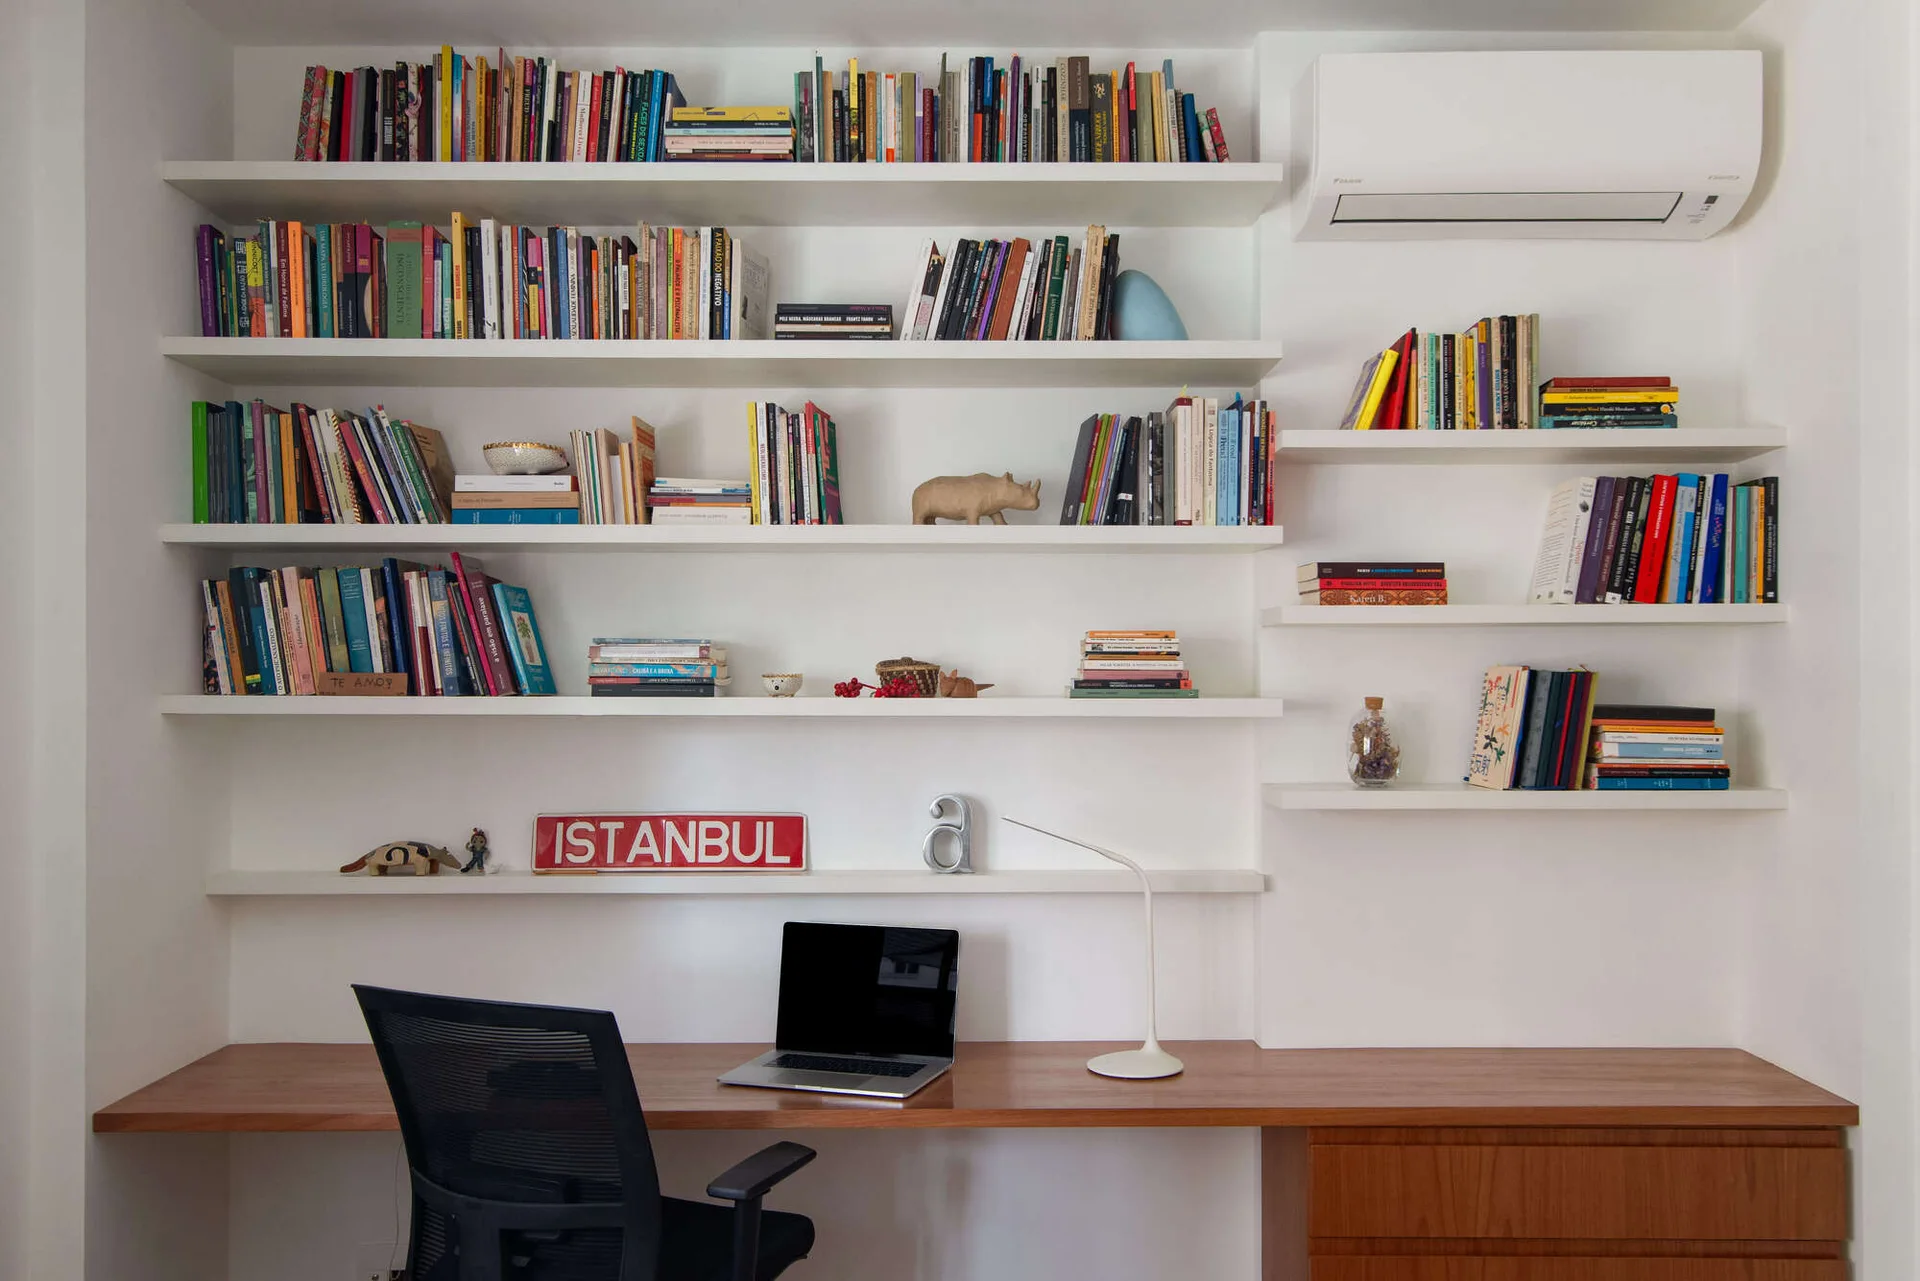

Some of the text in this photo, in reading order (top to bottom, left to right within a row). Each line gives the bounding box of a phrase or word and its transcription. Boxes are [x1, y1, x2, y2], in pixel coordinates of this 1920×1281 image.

[713, 237, 722, 261] PAIXÃO
[713, 261, 722, 272] DO
[569, 272, 577, 299] FEMININA
[713, 272, 722, 306] NEGATIVO
[1348, 594, 1376, 602] Karen
[476, 595, 491, 626] paralaxe
[487, 637, 498, 657] visão
[329, 678, 345, 689] TE
[554, 819, 791, 866] ISTANBUL
